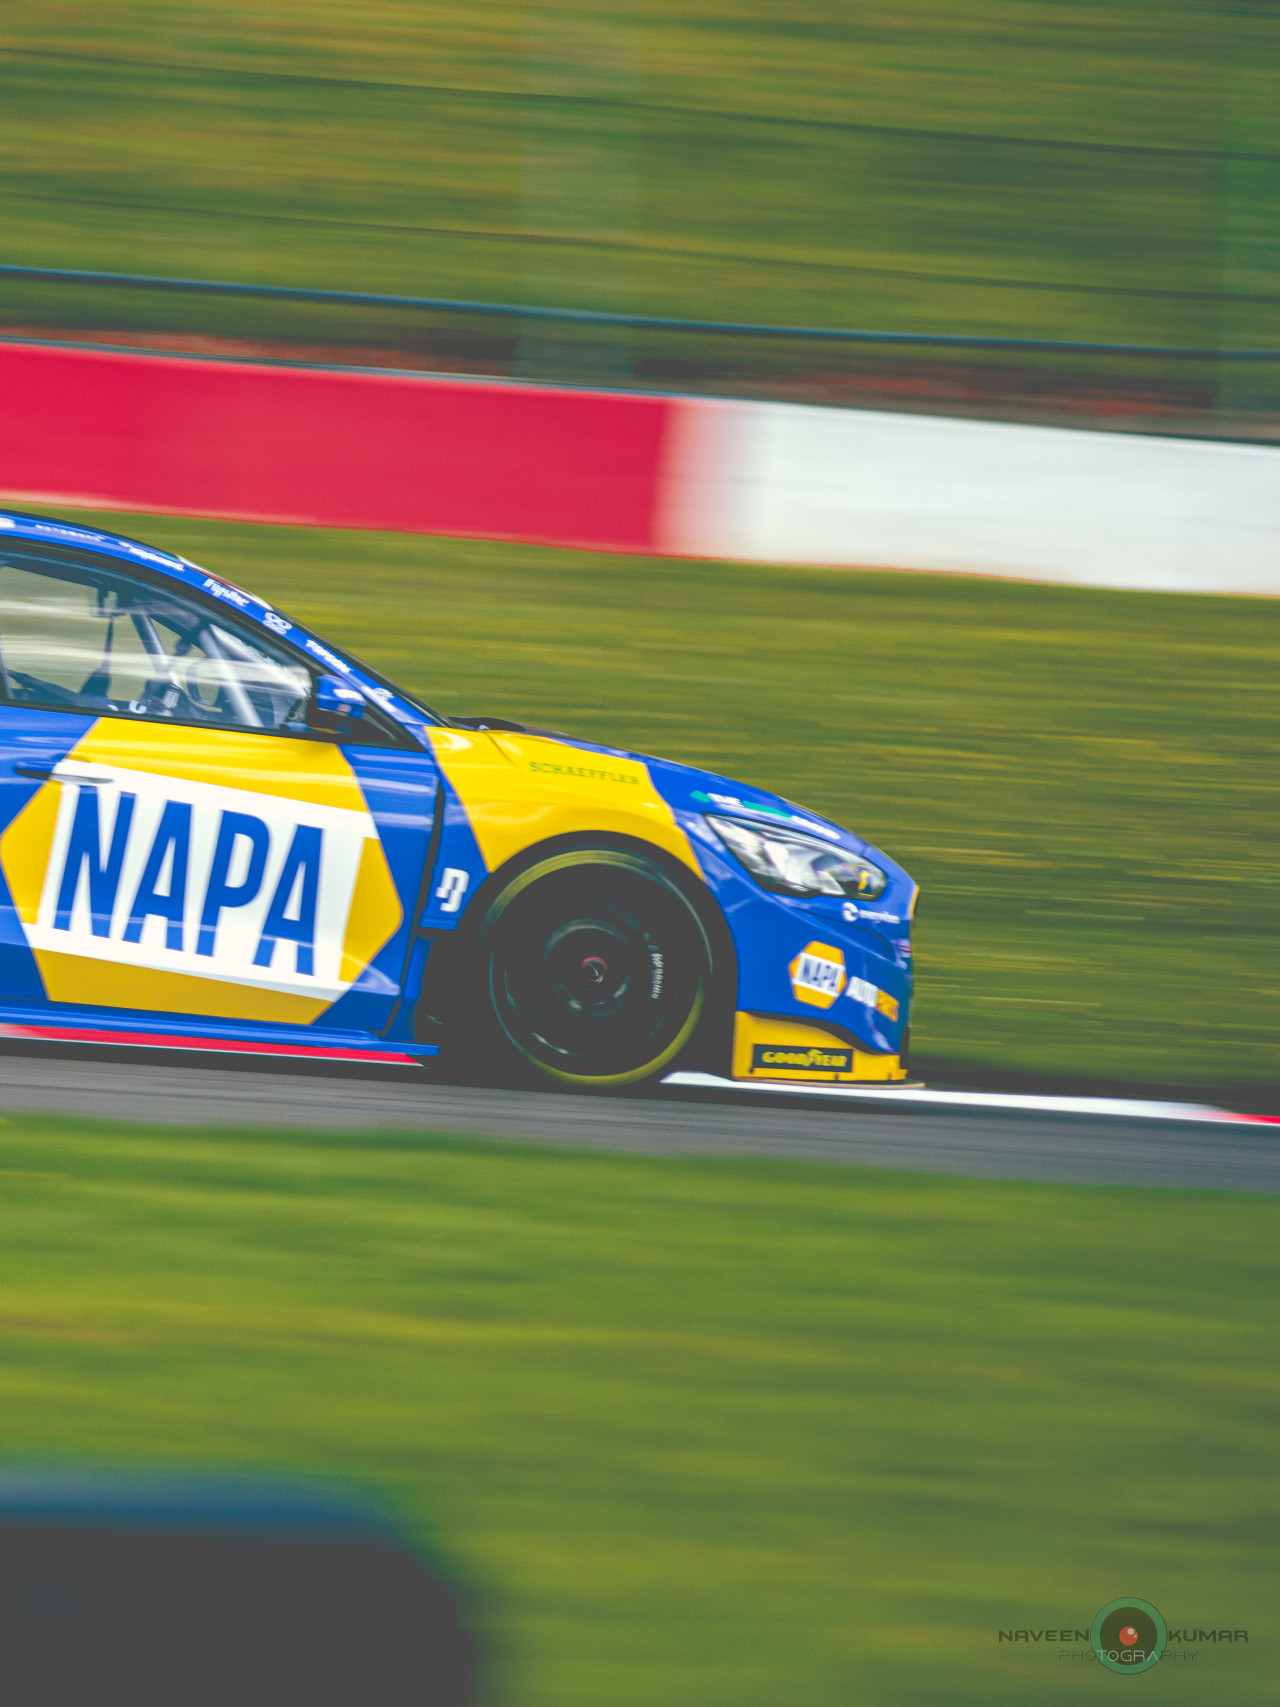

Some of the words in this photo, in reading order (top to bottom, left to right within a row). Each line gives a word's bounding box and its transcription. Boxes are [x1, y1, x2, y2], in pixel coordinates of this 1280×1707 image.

[528, 761, 641, 785] SCHAEFFLER
[51, 783, 325, 978] NAPA
[800, 955, 841, 994] NAPA
[761, 1048, 848, 1068] GOODYEAR
